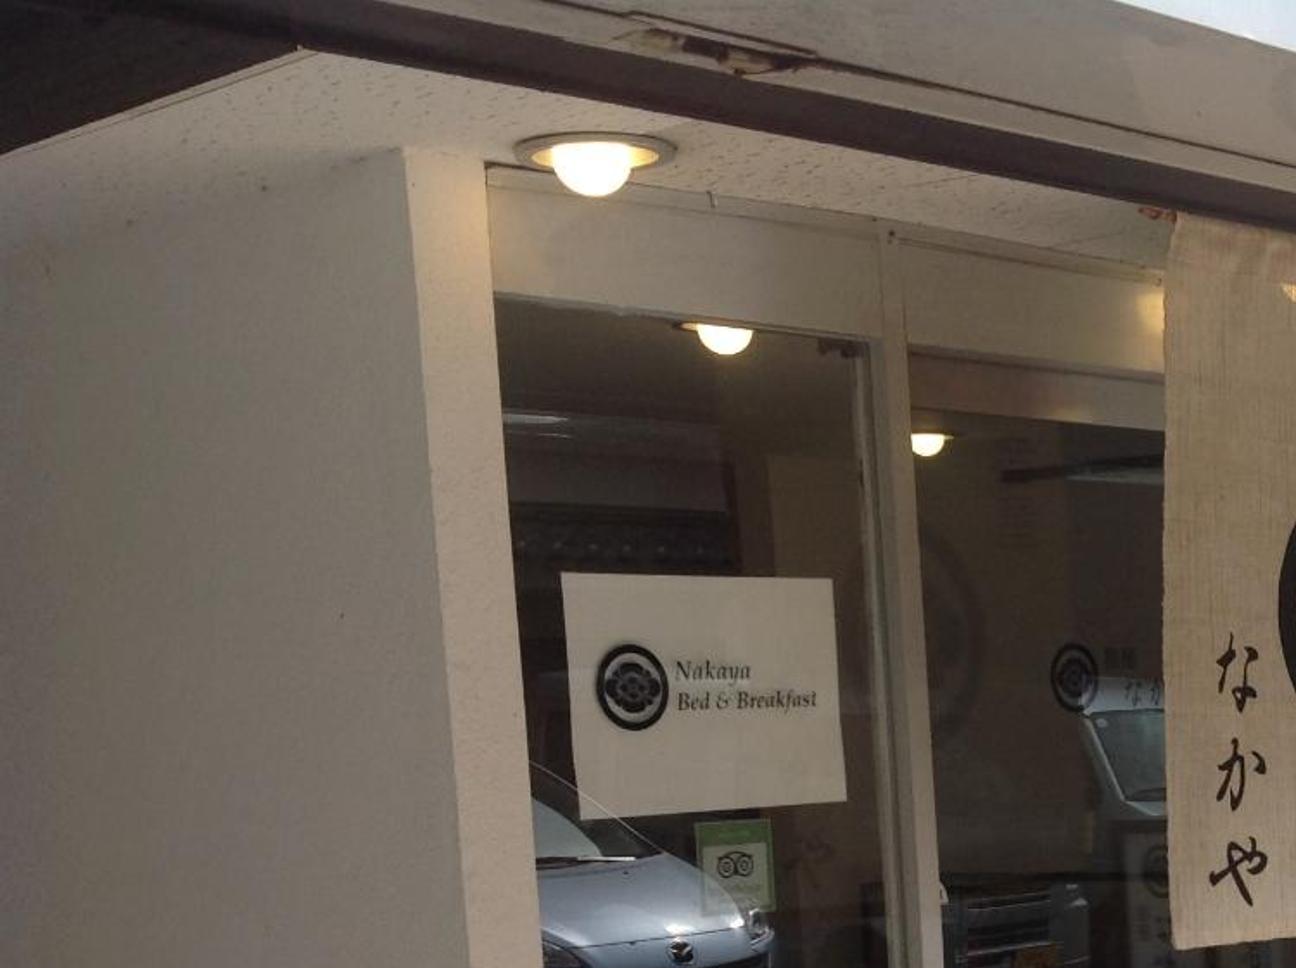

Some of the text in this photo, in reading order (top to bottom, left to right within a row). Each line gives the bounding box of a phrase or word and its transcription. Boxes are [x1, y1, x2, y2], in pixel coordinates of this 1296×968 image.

[675, 660, 751, 686] Nakaya
[677, 689, 817, 714] Bed & Breakfast
[1209, 632, 1268, 906] なかや
